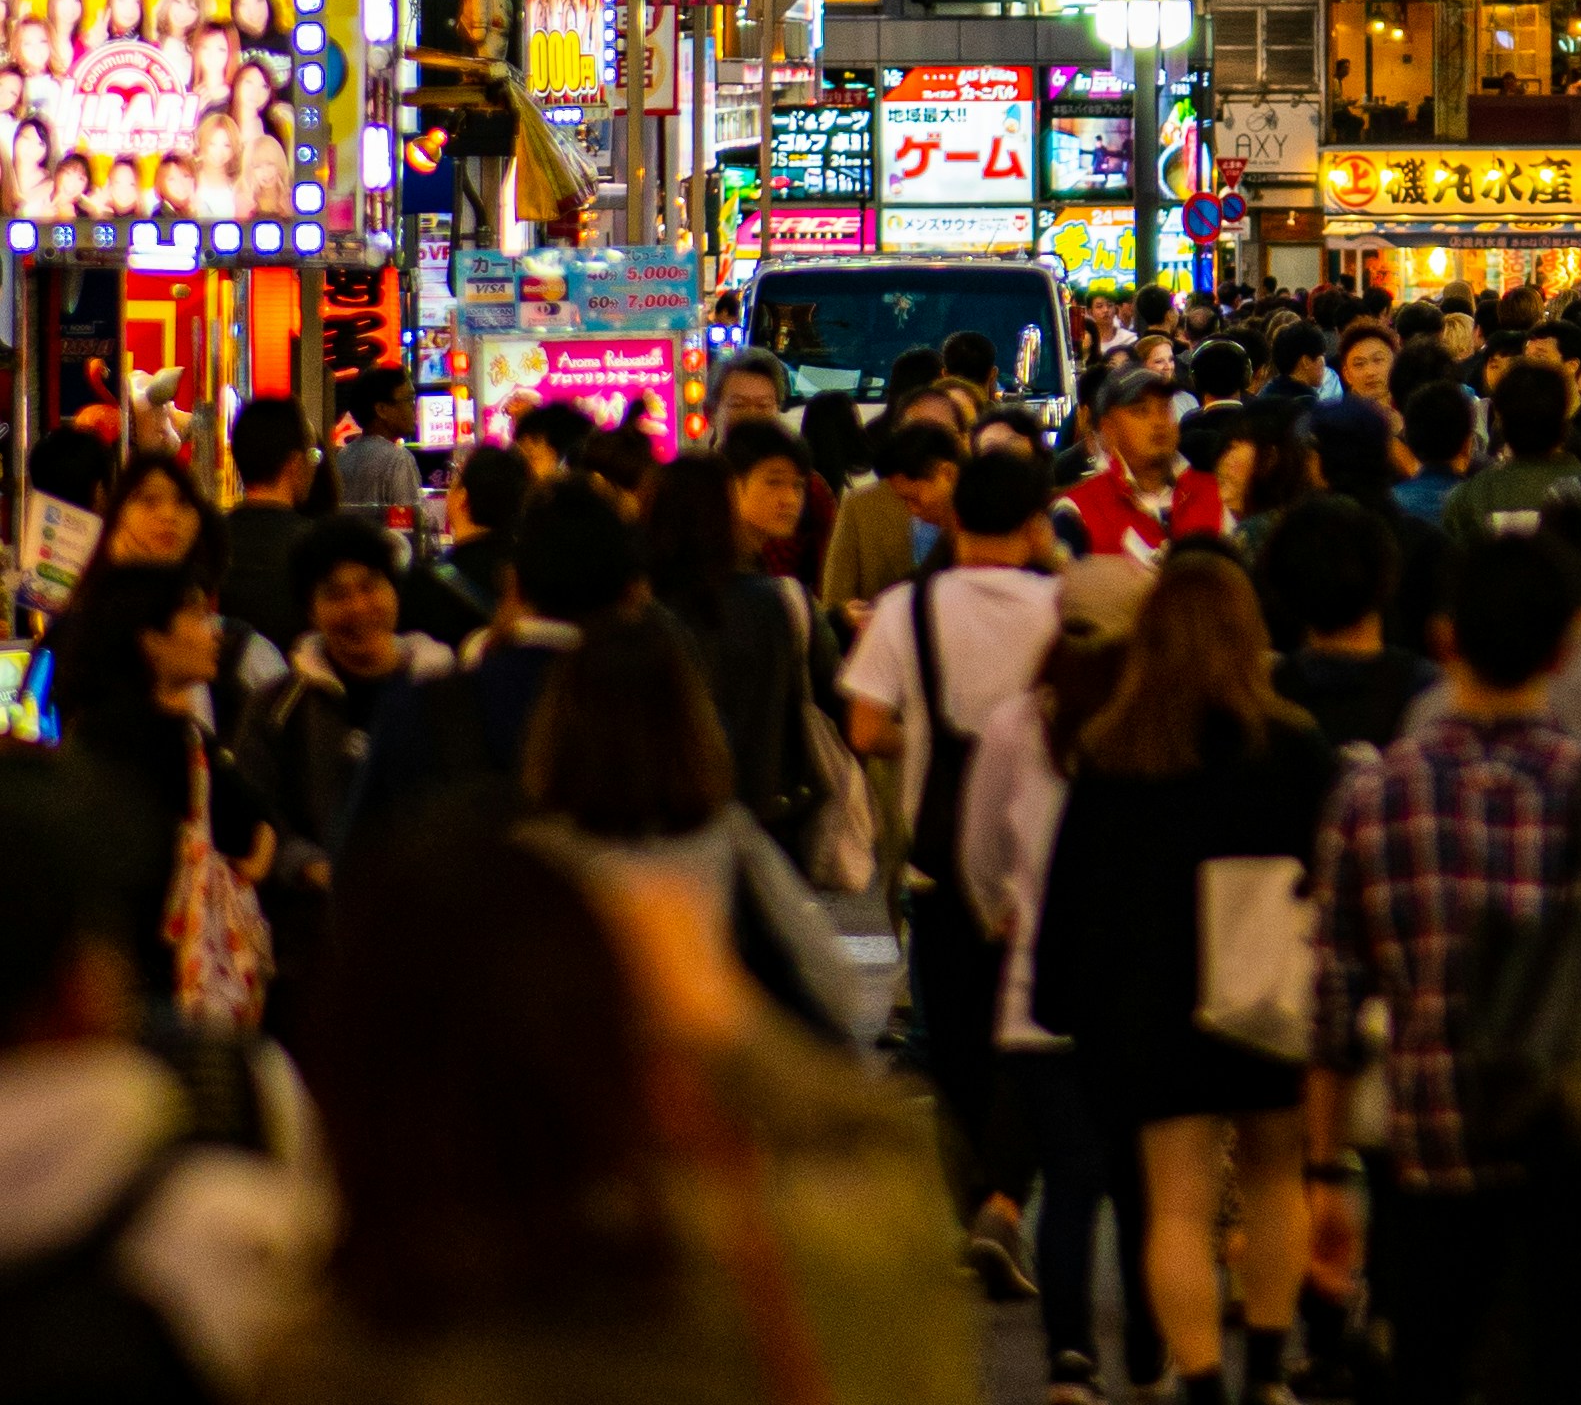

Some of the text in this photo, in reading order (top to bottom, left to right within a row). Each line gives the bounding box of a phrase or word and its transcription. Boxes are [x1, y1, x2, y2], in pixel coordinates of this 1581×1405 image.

[887, 107, 967, 124] 地域最大!!
[896, 131, 1027, 180] ゲーム
[1236, 133, 1288, 159] AXY
[1384, 155, 1574, 206] 磯丸水産
[557, 347, 665, 369] Aroma Relaxation
